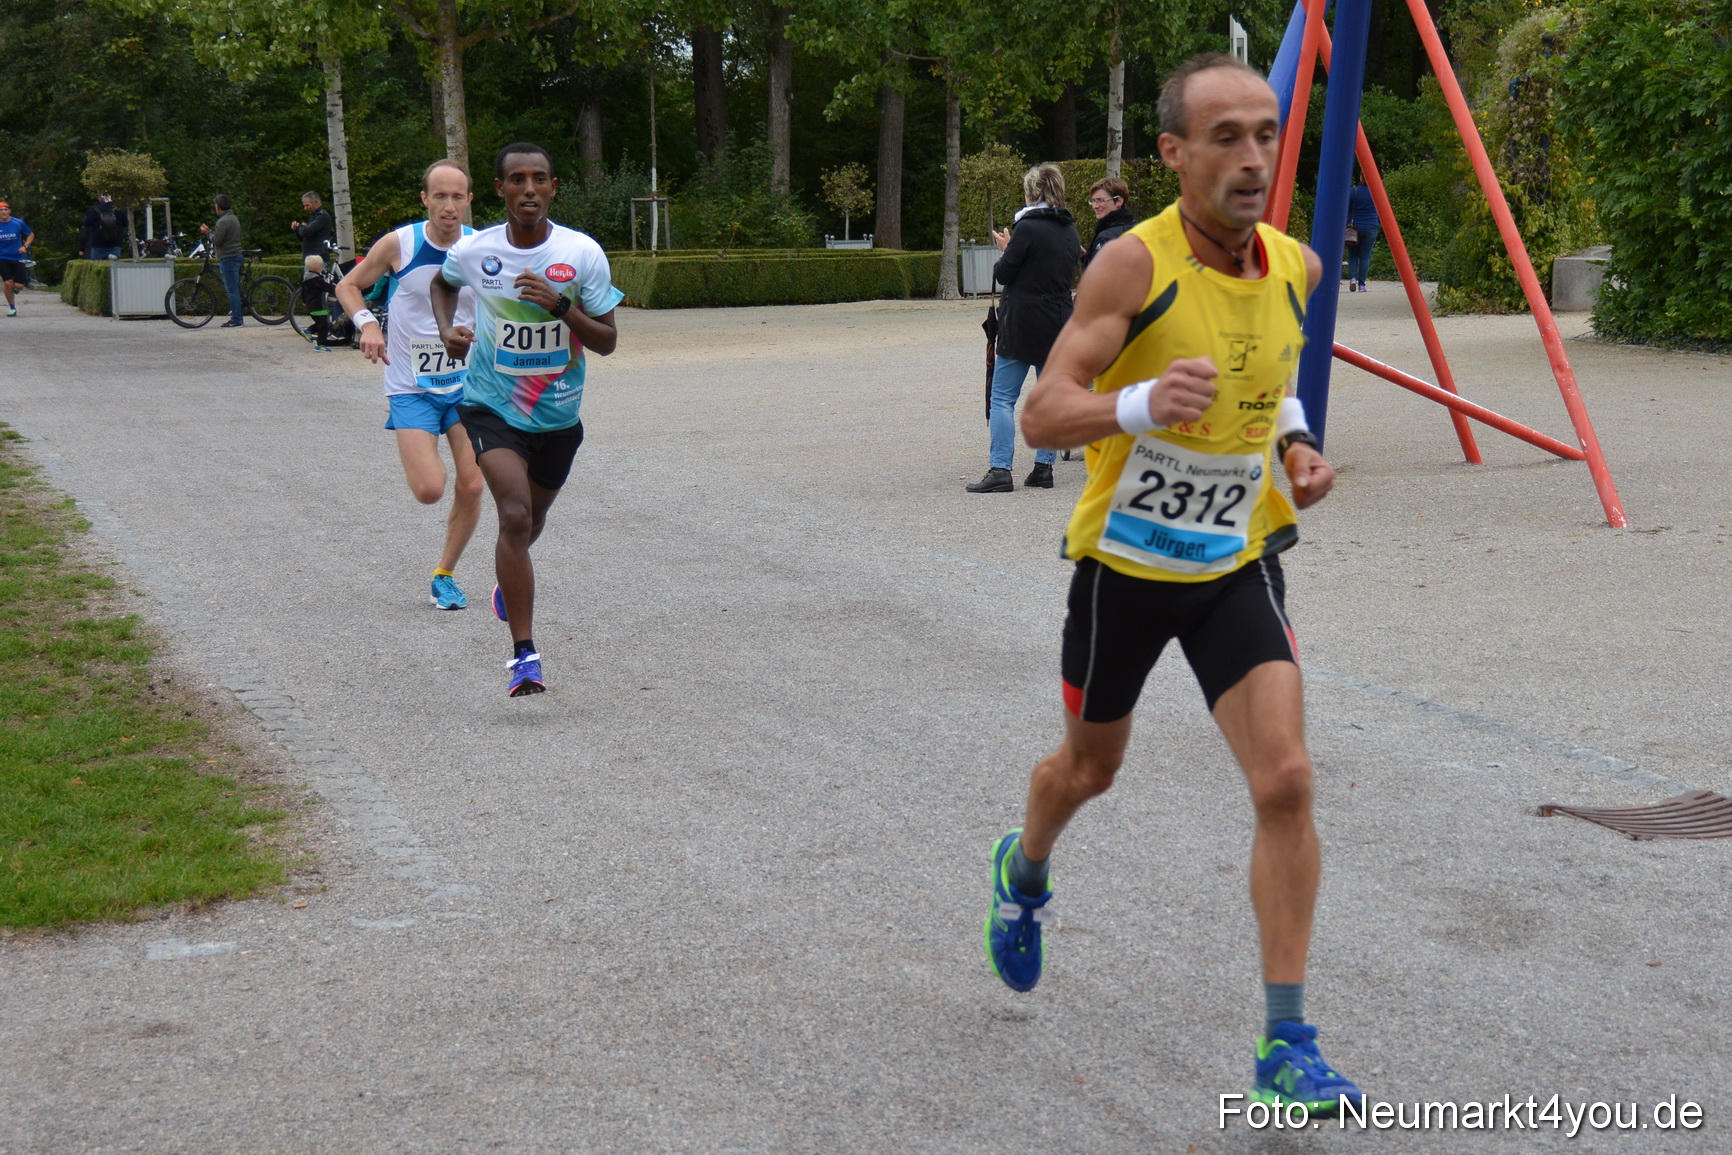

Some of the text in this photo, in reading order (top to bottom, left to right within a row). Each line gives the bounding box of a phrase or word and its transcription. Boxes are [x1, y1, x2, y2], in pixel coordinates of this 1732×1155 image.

[549, 267, 573, 279] Hervis
[482, 278, 503, 286] PARTL
[502, 323, 562, 351] 2011
[513, 355, 552, 367] Jamaal
[429, 375, 462, 387] Thomas
[553, 379, 570, 392] 16.
[1199, 422, 1212, 437] S
[1134, 444, 1247, 479] PARTL Neumarkt
[1128, 469, 1247, 528] 2312
[1144, 528, 1207, 559] Jürgen
